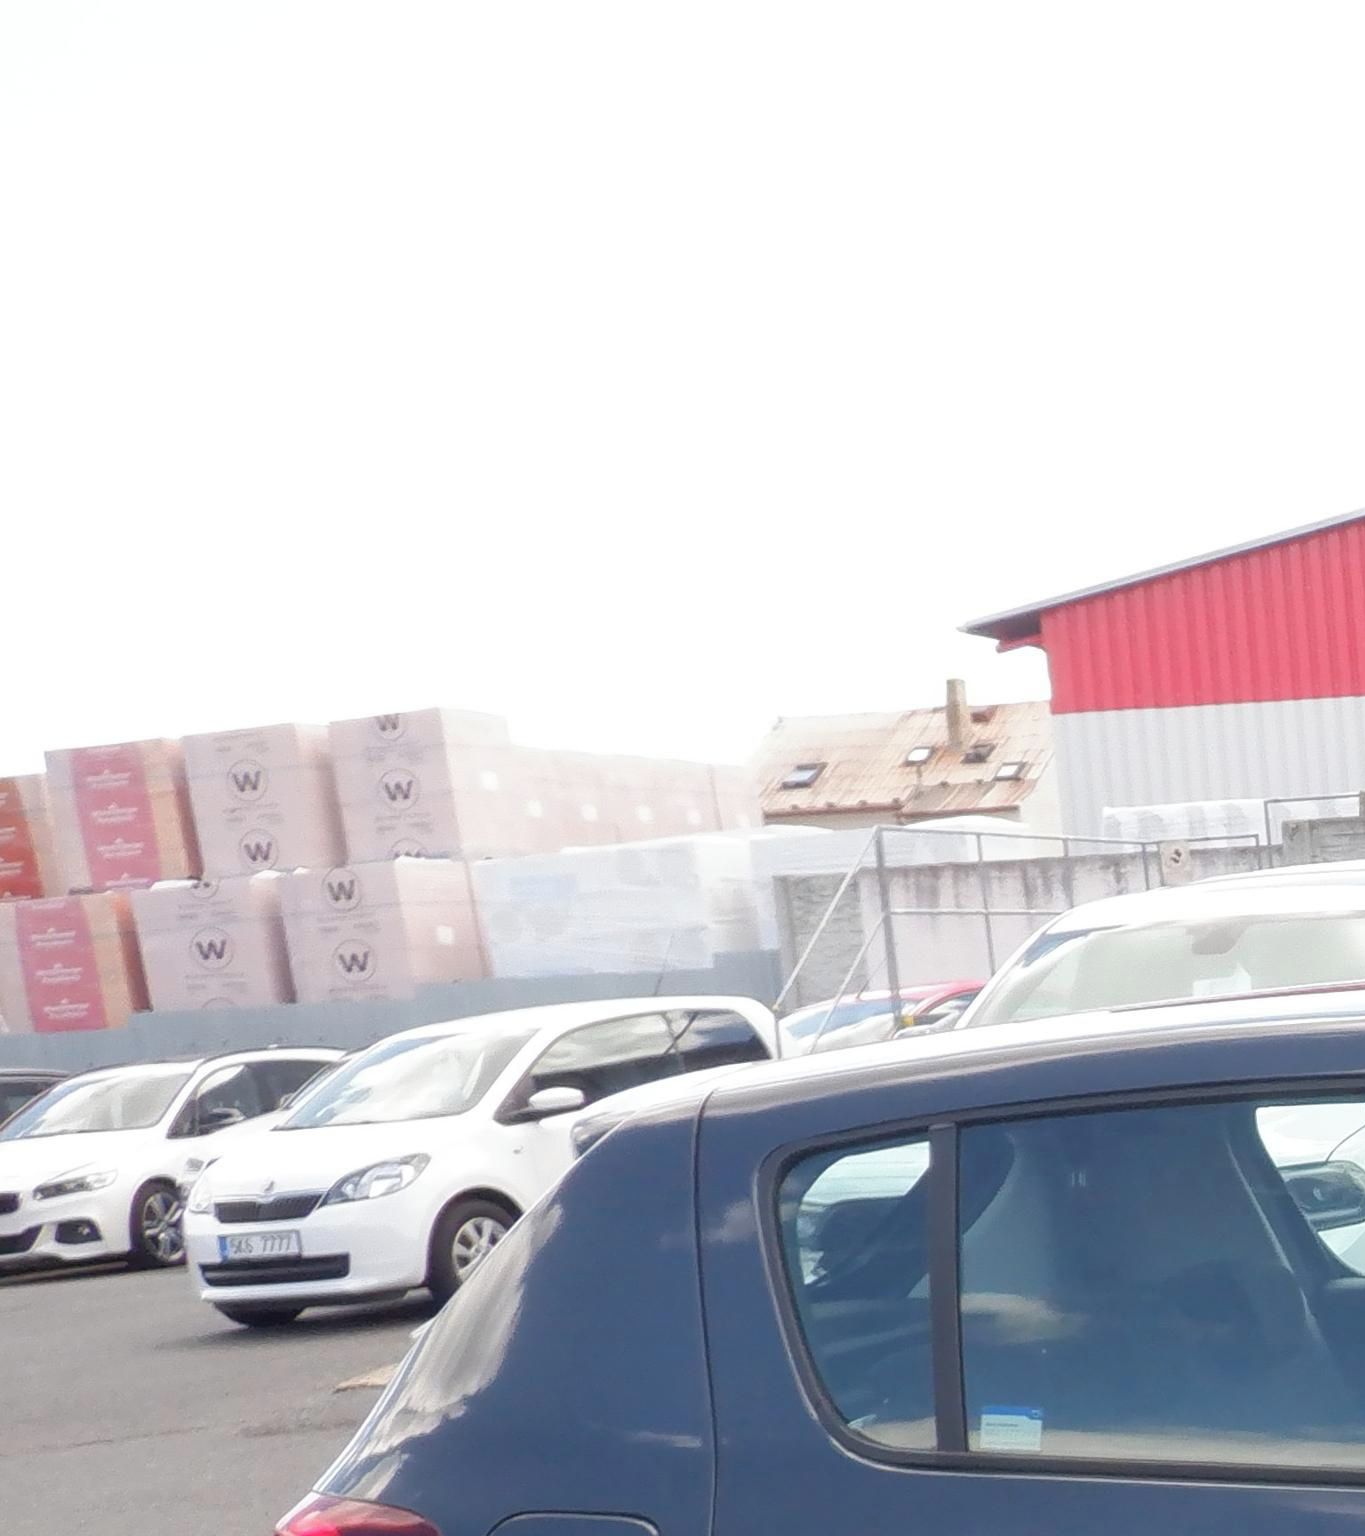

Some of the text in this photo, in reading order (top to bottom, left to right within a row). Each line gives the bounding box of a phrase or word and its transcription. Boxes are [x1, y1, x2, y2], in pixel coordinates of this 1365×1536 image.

[232, 770, 261, 792] W
[384, 780, 413, 801] W
[243, 841, 272, 862] W
[328, 880, 355, 902] W
[196, 939, 227, 960] W
[339, 950, 370, 973] W
